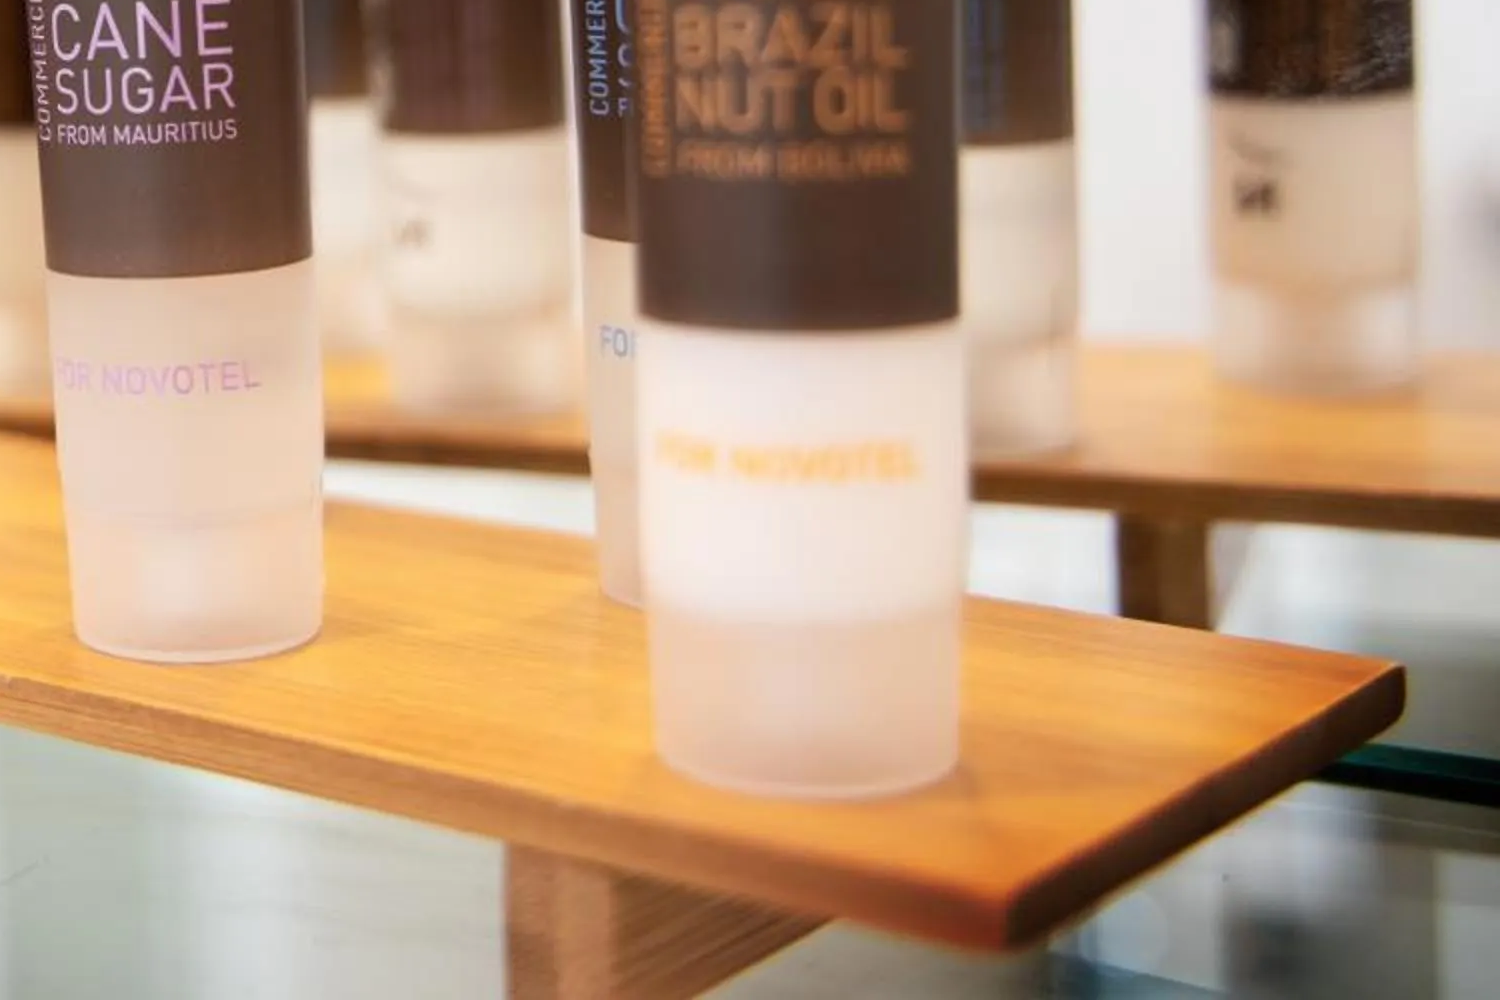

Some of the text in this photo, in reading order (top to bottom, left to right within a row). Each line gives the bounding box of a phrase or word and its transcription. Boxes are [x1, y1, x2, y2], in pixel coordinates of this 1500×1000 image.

[672, 2, 907, 69] BRAZIL
[55, 63, 236, 115] SUGAR
[674, 66, 907, 135] NUT OIL
[57, 118, 239, 146] FROM MAURITIUS
[101, 360, 262, 396] NOVOTEL
